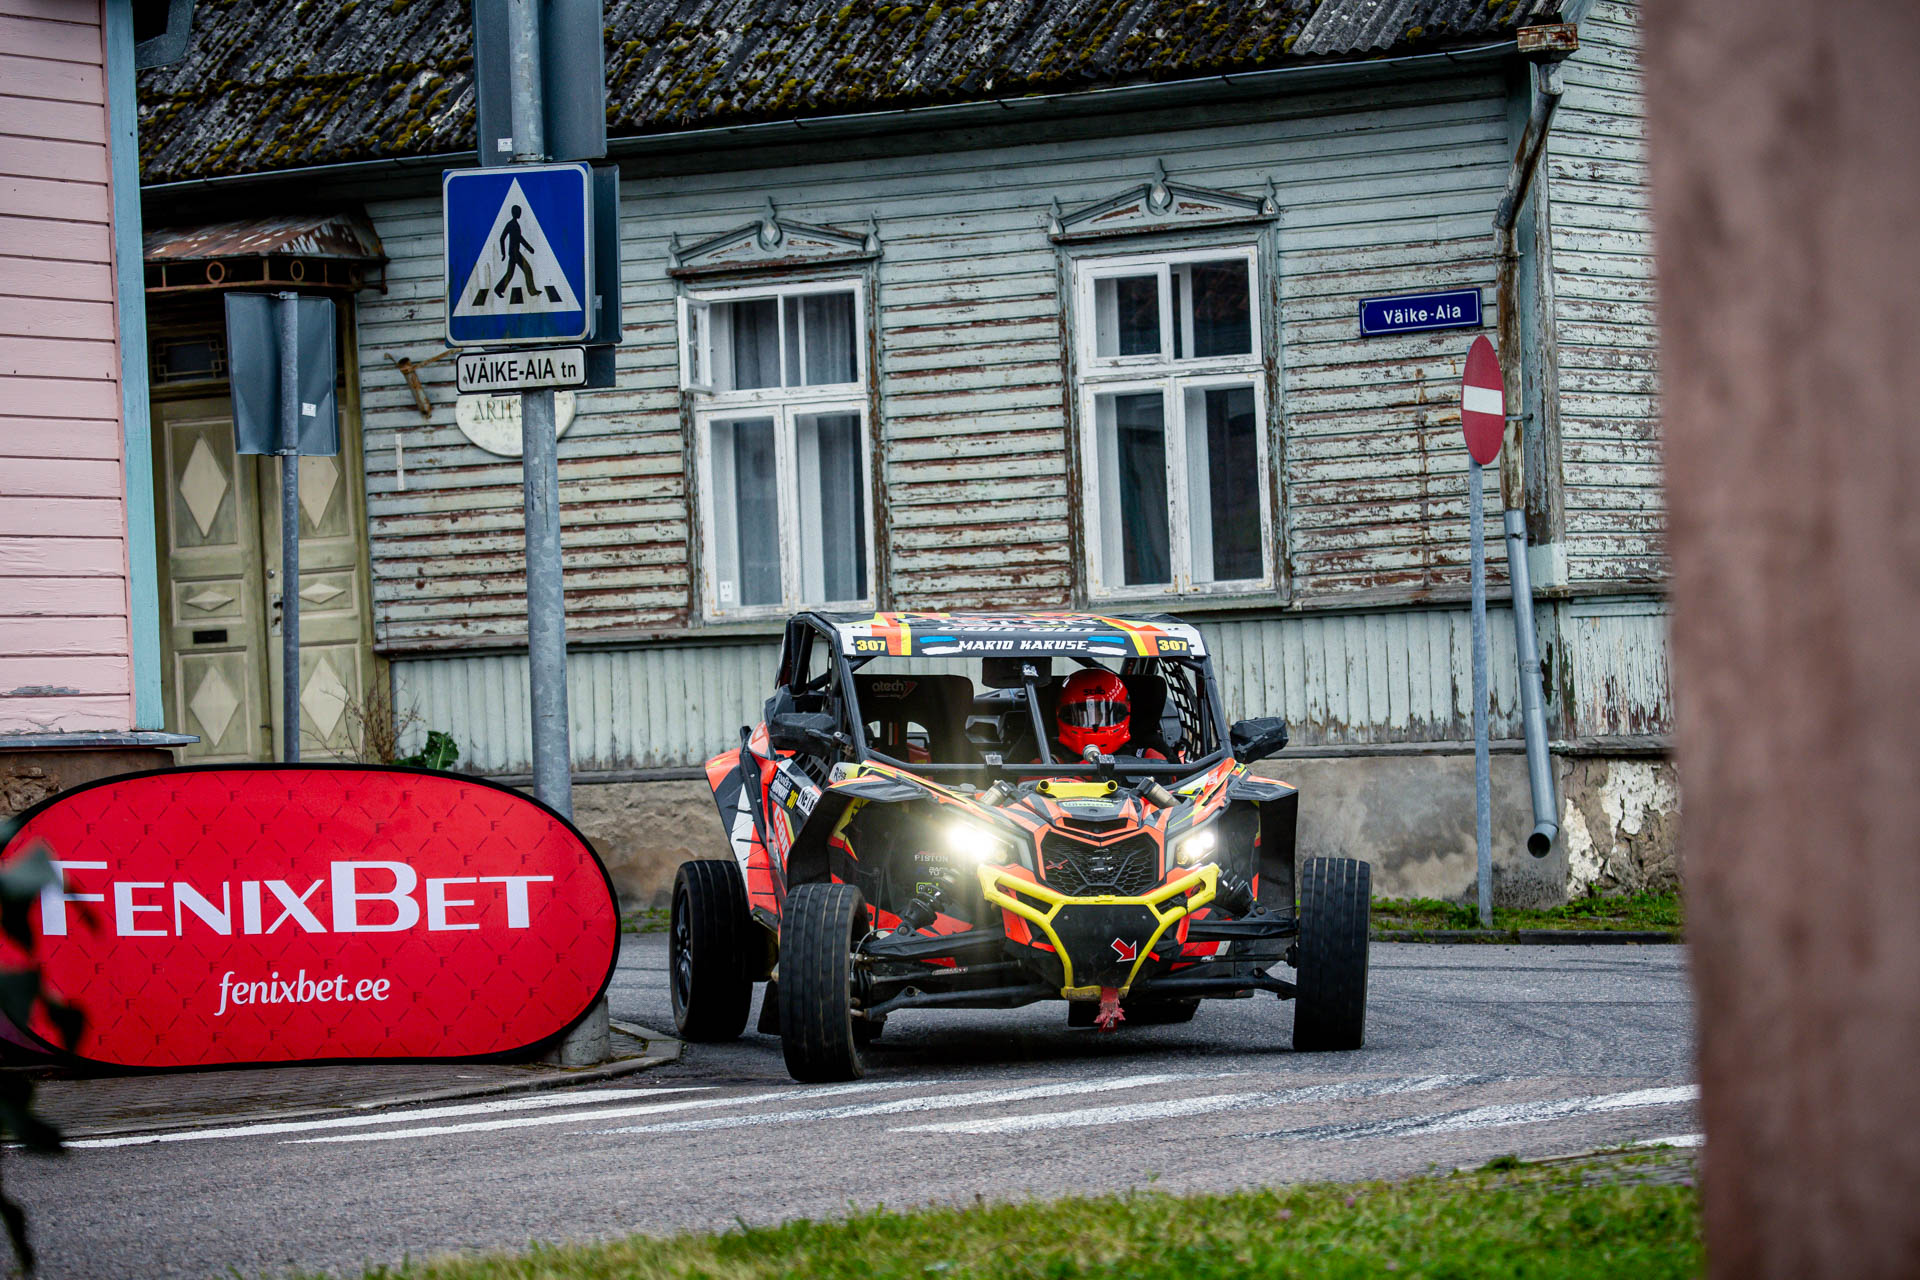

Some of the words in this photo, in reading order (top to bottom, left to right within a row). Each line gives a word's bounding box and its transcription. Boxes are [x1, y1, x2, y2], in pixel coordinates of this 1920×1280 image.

[1383, 304, 1462, 325] Väike-Aia
[465, 357, 555, 384] VÄIKE-AIA
[561, 361, 577, 378] tn
[856, 640, 887, 651] 307
[1158, 639, 1188, 651] 307
[113, 790, 123, 801] F
[171, 791, 181, 802] F
[230, 791, 240, 802] F
[288, 790, 298, 801] F
[345, 790, 355, 801] F
[402, 790, 412, 801] F
[460, 789, 470, 800] F
[86, 824, 96, 835] F
[144, 824, 154, 835] F
[202, 824, 212, 835] F
[260, 824, 270, 835] F
[318, 823, 328, 834] F
[376, 823, 386, 834] F
[433, 822, 443, 833] F
[490, 821, 500, 832] F
[548, 821, 558, 832] F
[117, 858, 127, 869] F
[175, 859, 185, 870] F
[233, 858, 243, 869] F
[291, 857, 301, 868] F
[407, 856, 416, 865] F
[464, 855, 474, 866] F
[521, 854, 531, 865] F
[579, 854, 589, 865] F
[321, 891, 331, 902] F
[494, 888, 504, 899] F
[552, 886, 562, 897] F
[149, 894, 157, 905] F
[264, 893, 274, 904] F
[583, 920, 593, 931] F
[236, 928, 245, 939] F
[294, 926, 304, 937] F
[440, 957, 450, 968] F
[498, 954, 508, 965] F
[556, 952, 566, 963] F
[94, 963, 104, 974] F
[152, 963, 162, 974] F
[209, 962, 219, 973] F
[266, 960, 276, 971] F
[324, 959, 334, 970] F
[382, 958, 392, 969] F
[214, 969, 390, 1016] fenixbet.ee
[470, 989, 480, 1000] F
[528, 987, 538, 998] F
[587, 986, 597, 997] F
[413, 992, 423, 1003] F
[125, 998, 135, 1009] F
[182, 998, 192, 1009] F
[327, 1027, 337, 1038] F
[385, 1026, 395, 1037] F
[443, 1025, 453, 1036] F
[502, 1022, 512, 1033] F
[98, 1034, 108, 1045] F
[155, 1034, 165, 1045] F
[212, 1032, 222, 1043] F
[269, 1030, 279, 1041] F
